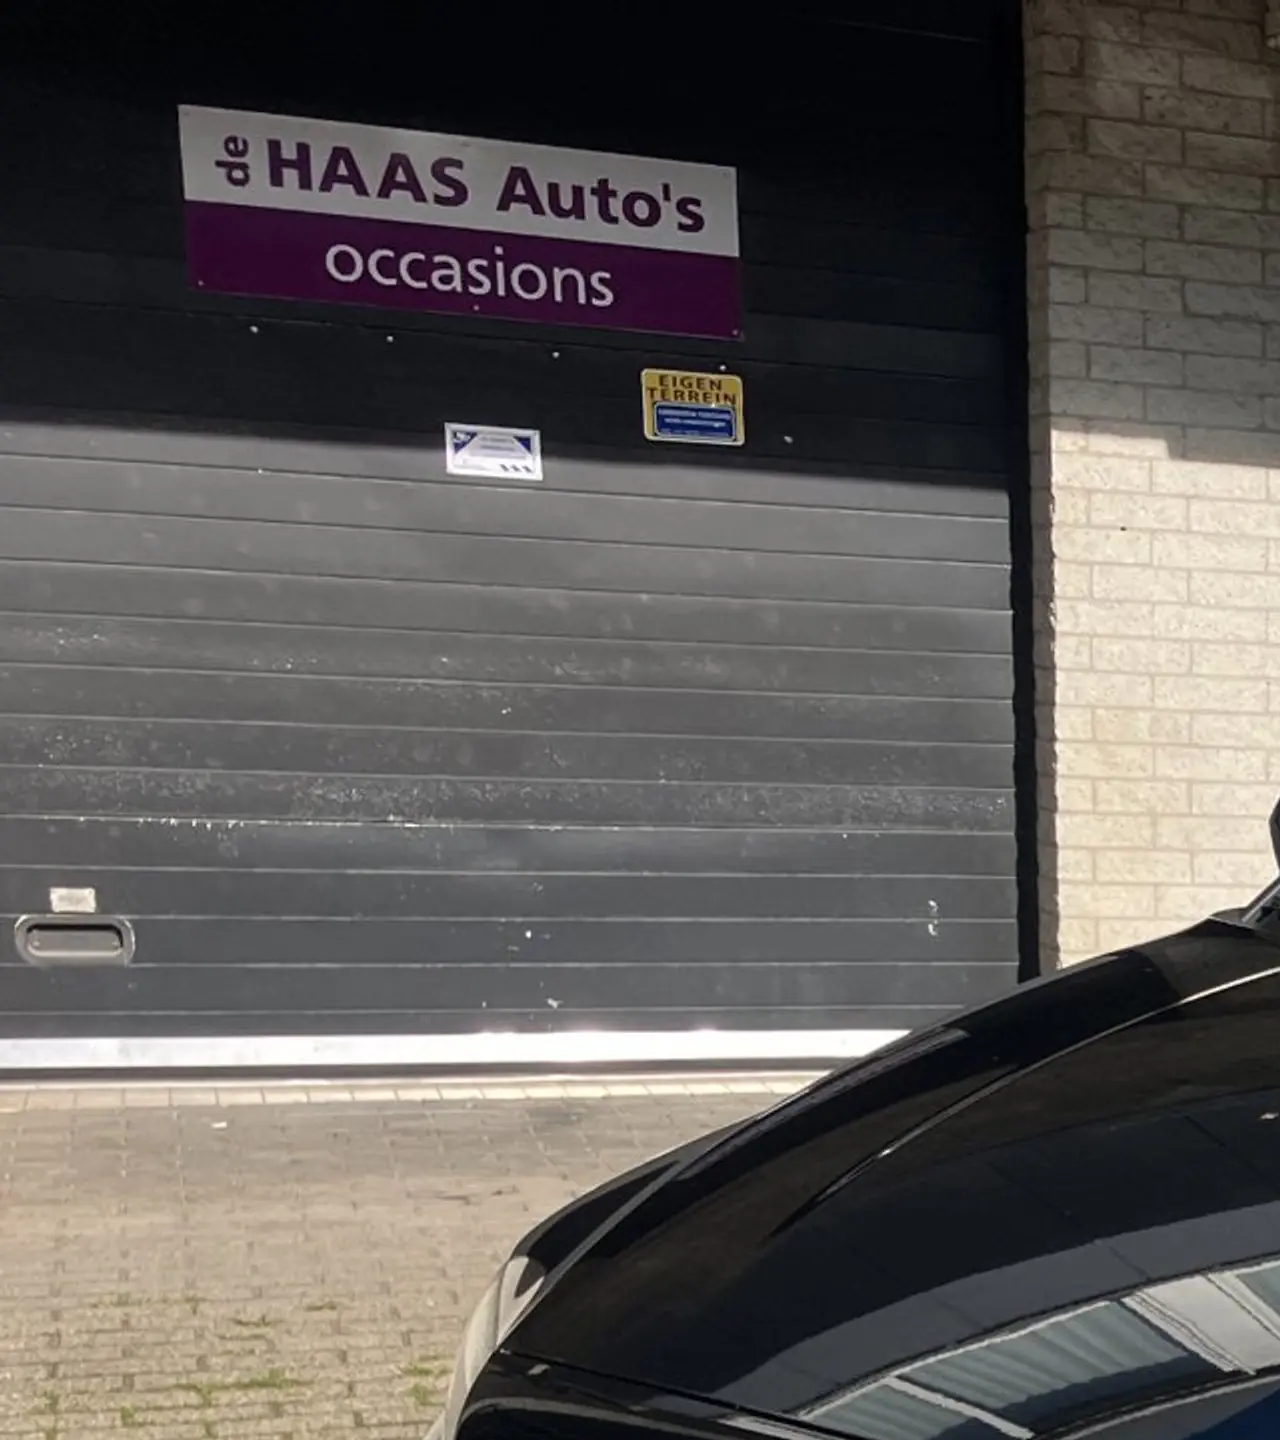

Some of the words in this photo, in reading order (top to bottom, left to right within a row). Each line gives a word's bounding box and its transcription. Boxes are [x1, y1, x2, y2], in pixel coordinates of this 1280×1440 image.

[215, 135, 250, 187] de
[267, 138, 469, 207] HAAS
[496, 165, 705, 233] Auto's
[325, 243, 614, 307] occasions
[647, 388, 736, 404] TERREIN
[659, 375, 722, 391] EIGEN
